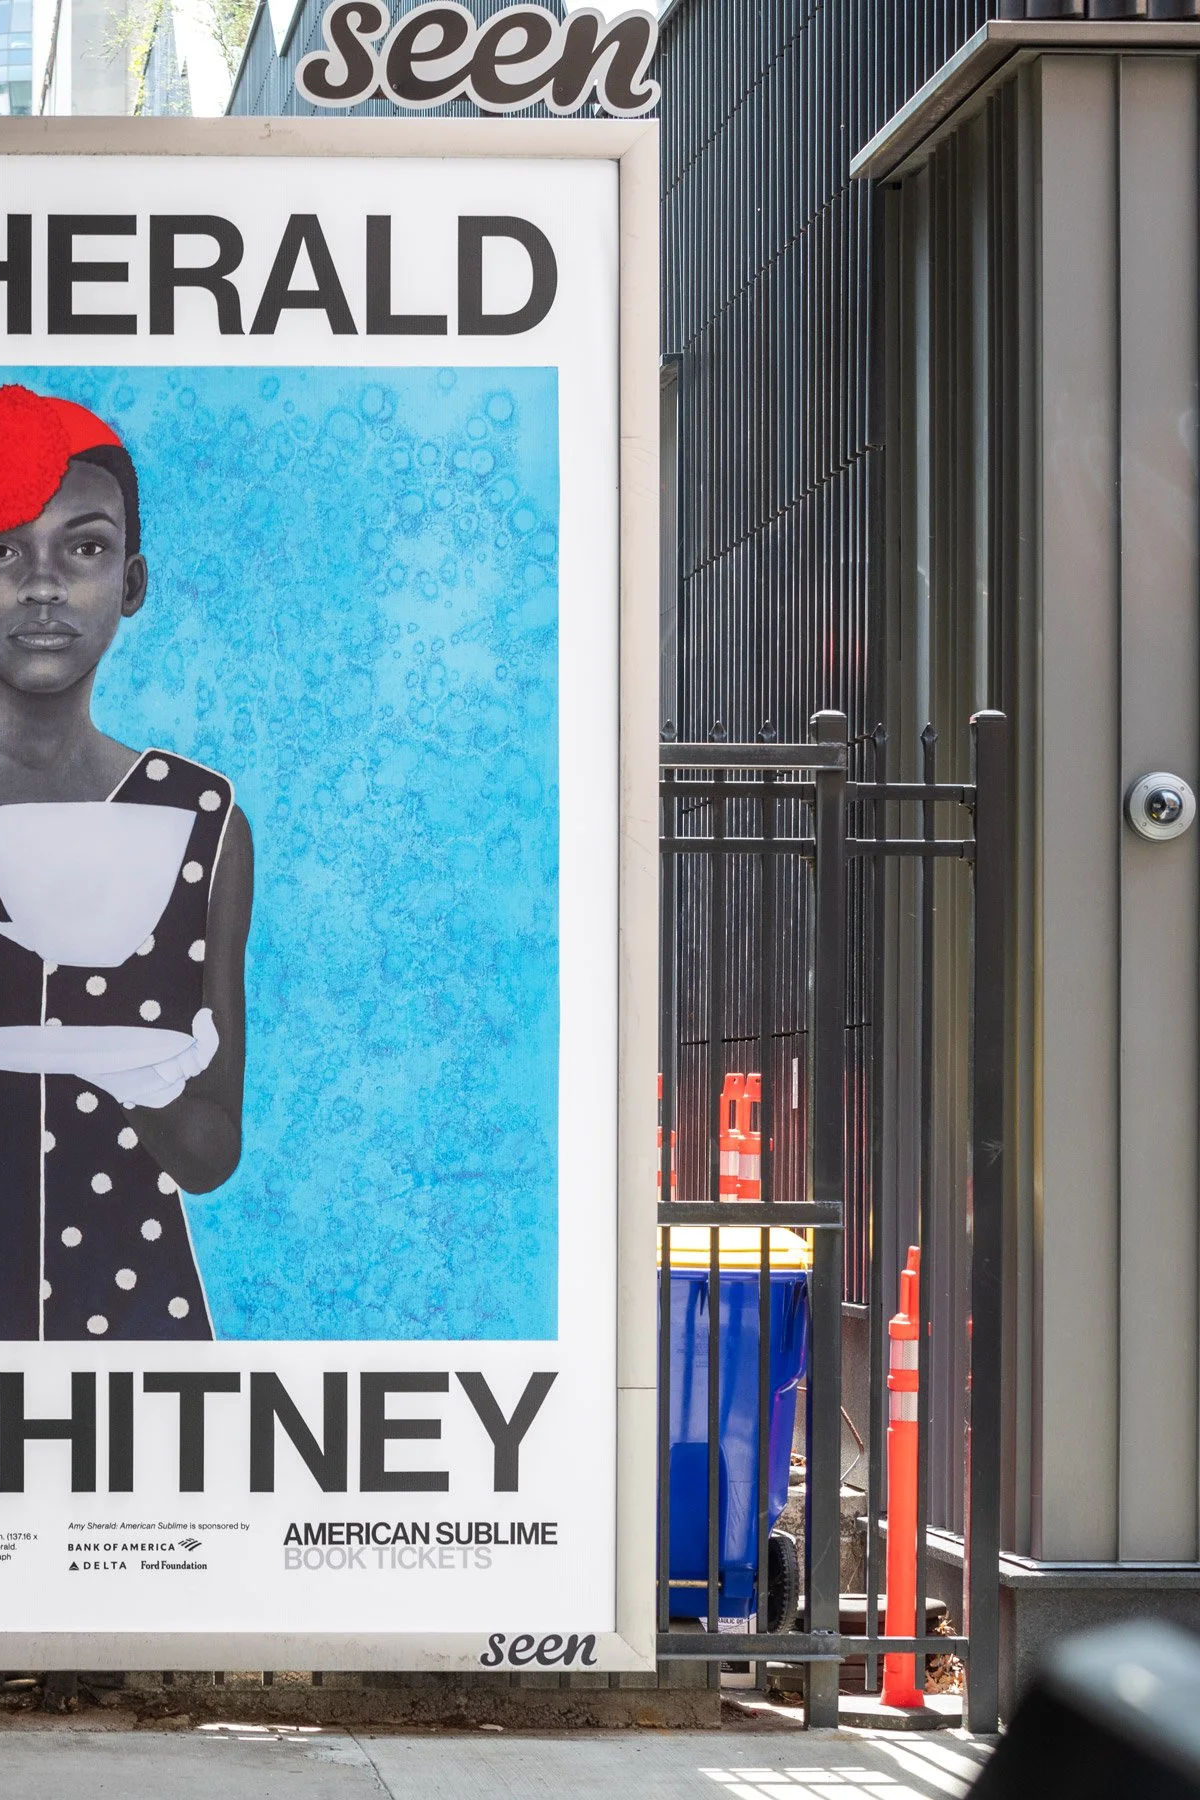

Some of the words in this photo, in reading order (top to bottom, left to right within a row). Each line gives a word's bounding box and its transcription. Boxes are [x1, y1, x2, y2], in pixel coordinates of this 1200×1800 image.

[302, 1, 654, 110] seen
[67, 1522, 86, 1532] Amy
[119, 1521, 156, 1530] American
[157, 1521, 188, 1530] Sublime
[189, 1522, 197, 1530] is
[197, 1522, 239, 1531] sponsored
[240, 1522, 250, 1532] by
[284, 1522, 429, 1545] AMERICAN
[436, 1522, 557, 1545] SUBLIME
[67, 1543, 100, 1552] BANK
[103, 1542, 119, 1552] OF
[121, 1542, 176, 1552] AMERICA
[83, 1561, 127, 1570] DELTA
[140, 1560, 160, 1570] Ford
[160, 1560, 208, 1570] Foundation
[285, 1547, 366, 1570] BOOK
[372, 1546, 492, 1569] TICKETS
[480, 1632, 598, 1667] seen
